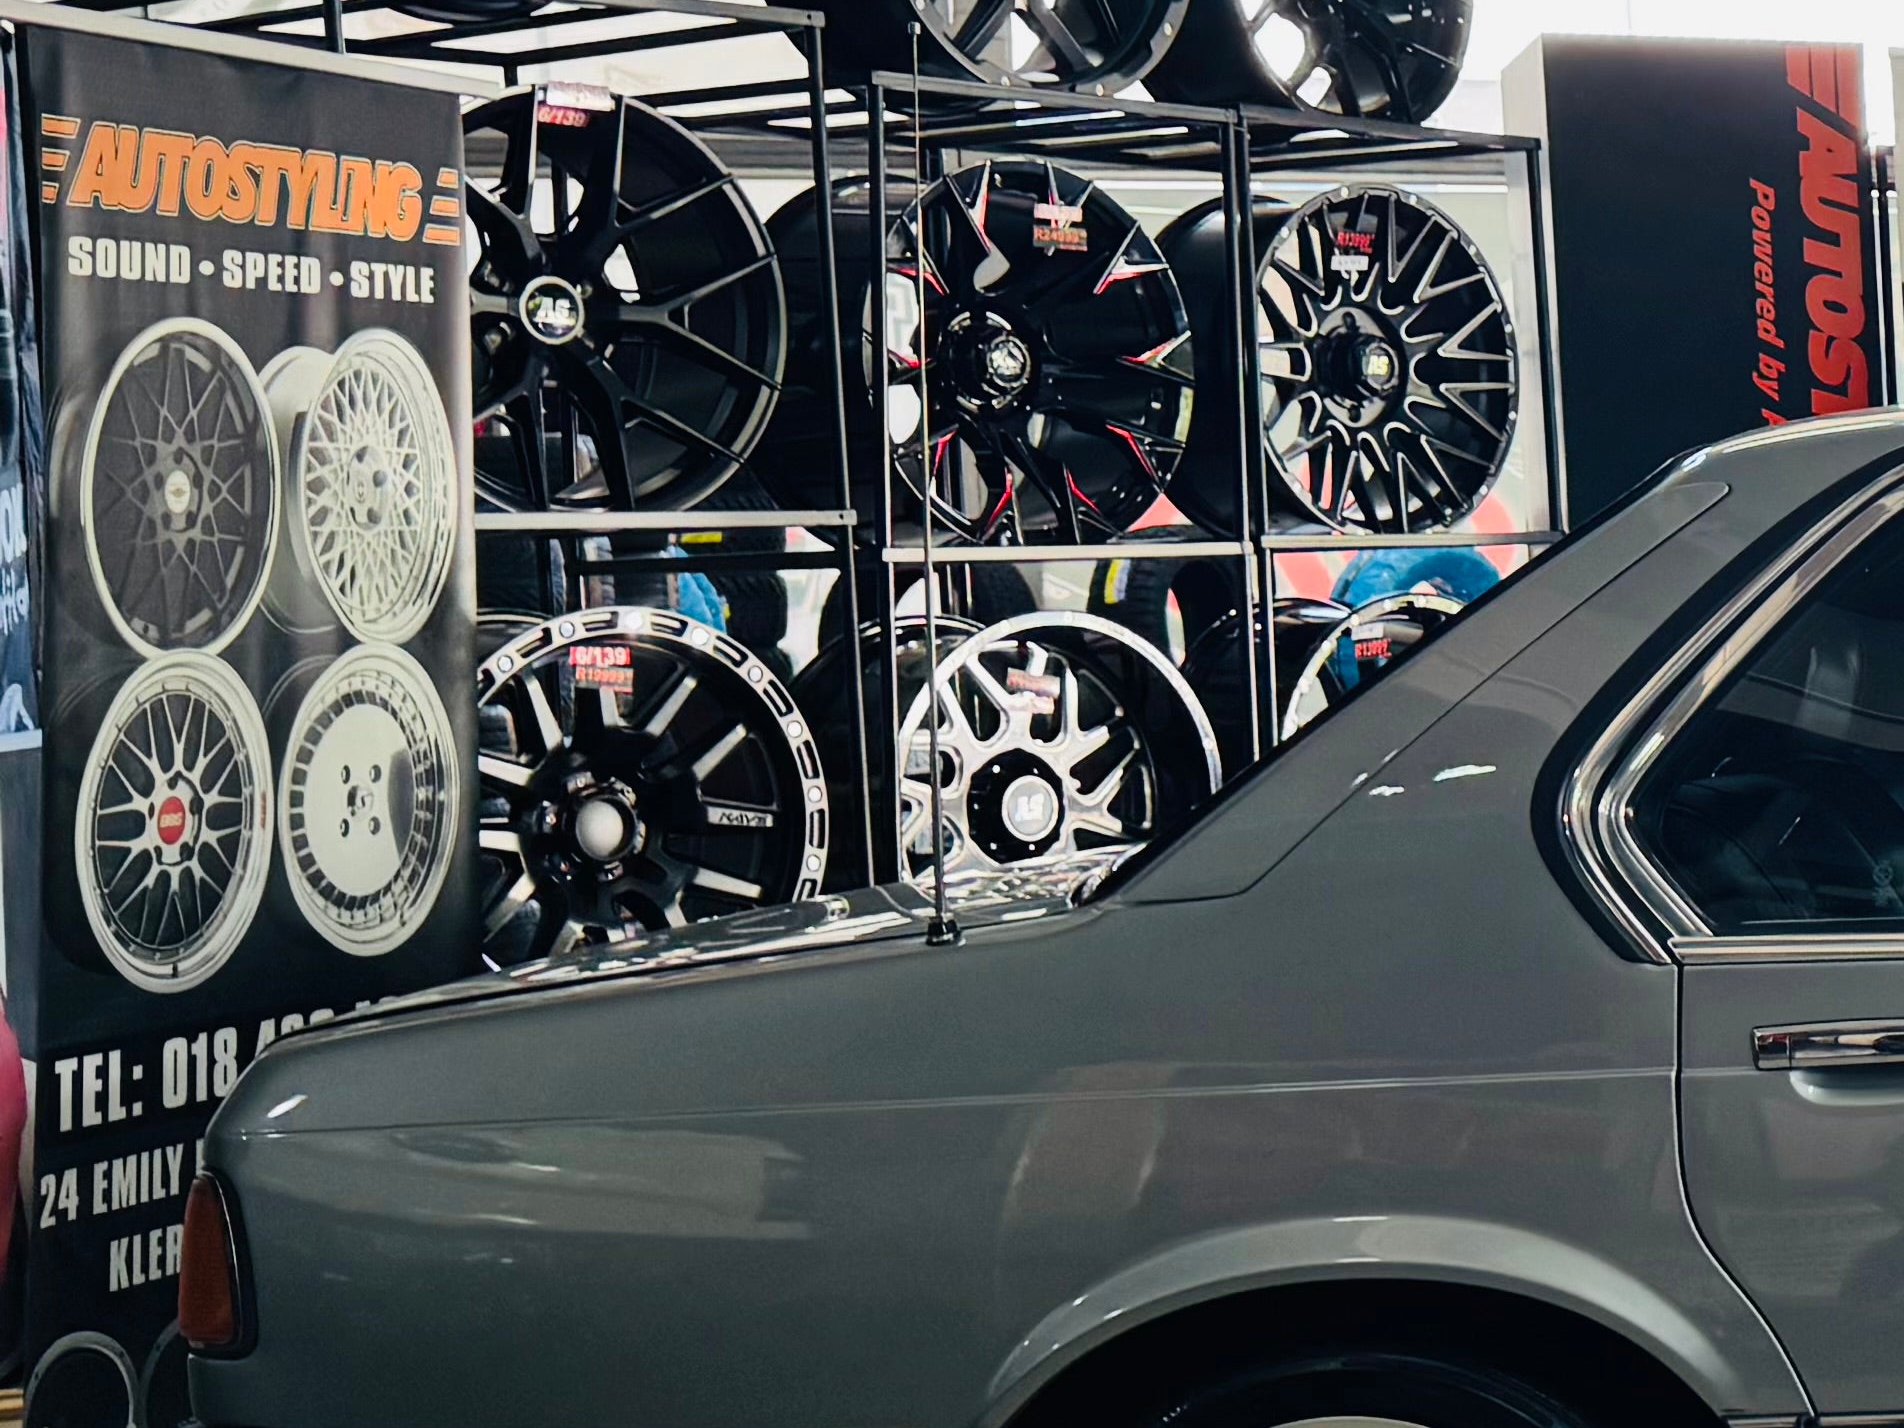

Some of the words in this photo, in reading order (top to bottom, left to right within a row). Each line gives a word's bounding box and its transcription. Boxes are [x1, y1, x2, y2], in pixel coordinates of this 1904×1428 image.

[66, 121, 424, 242] AUTOSTYLING
[68, 236, 191, 285] SOUND
[222, 248, 321, 295] SPEED
[350, 260, 435, 304] STYLE
[1749, 177, 1786, 350] Powered
[1797, 106, 1869, 417] AUTOST
[1752, 358, 1787, 401] by
[54, 1049, 144, 1134] TEL:
[162, 1026, 238, 1109] 018
[39, 1167, 79, 1230] 24
[92, 1142, 185, 1215] EMILY
[108, 1224, 183, 1292] KLER
